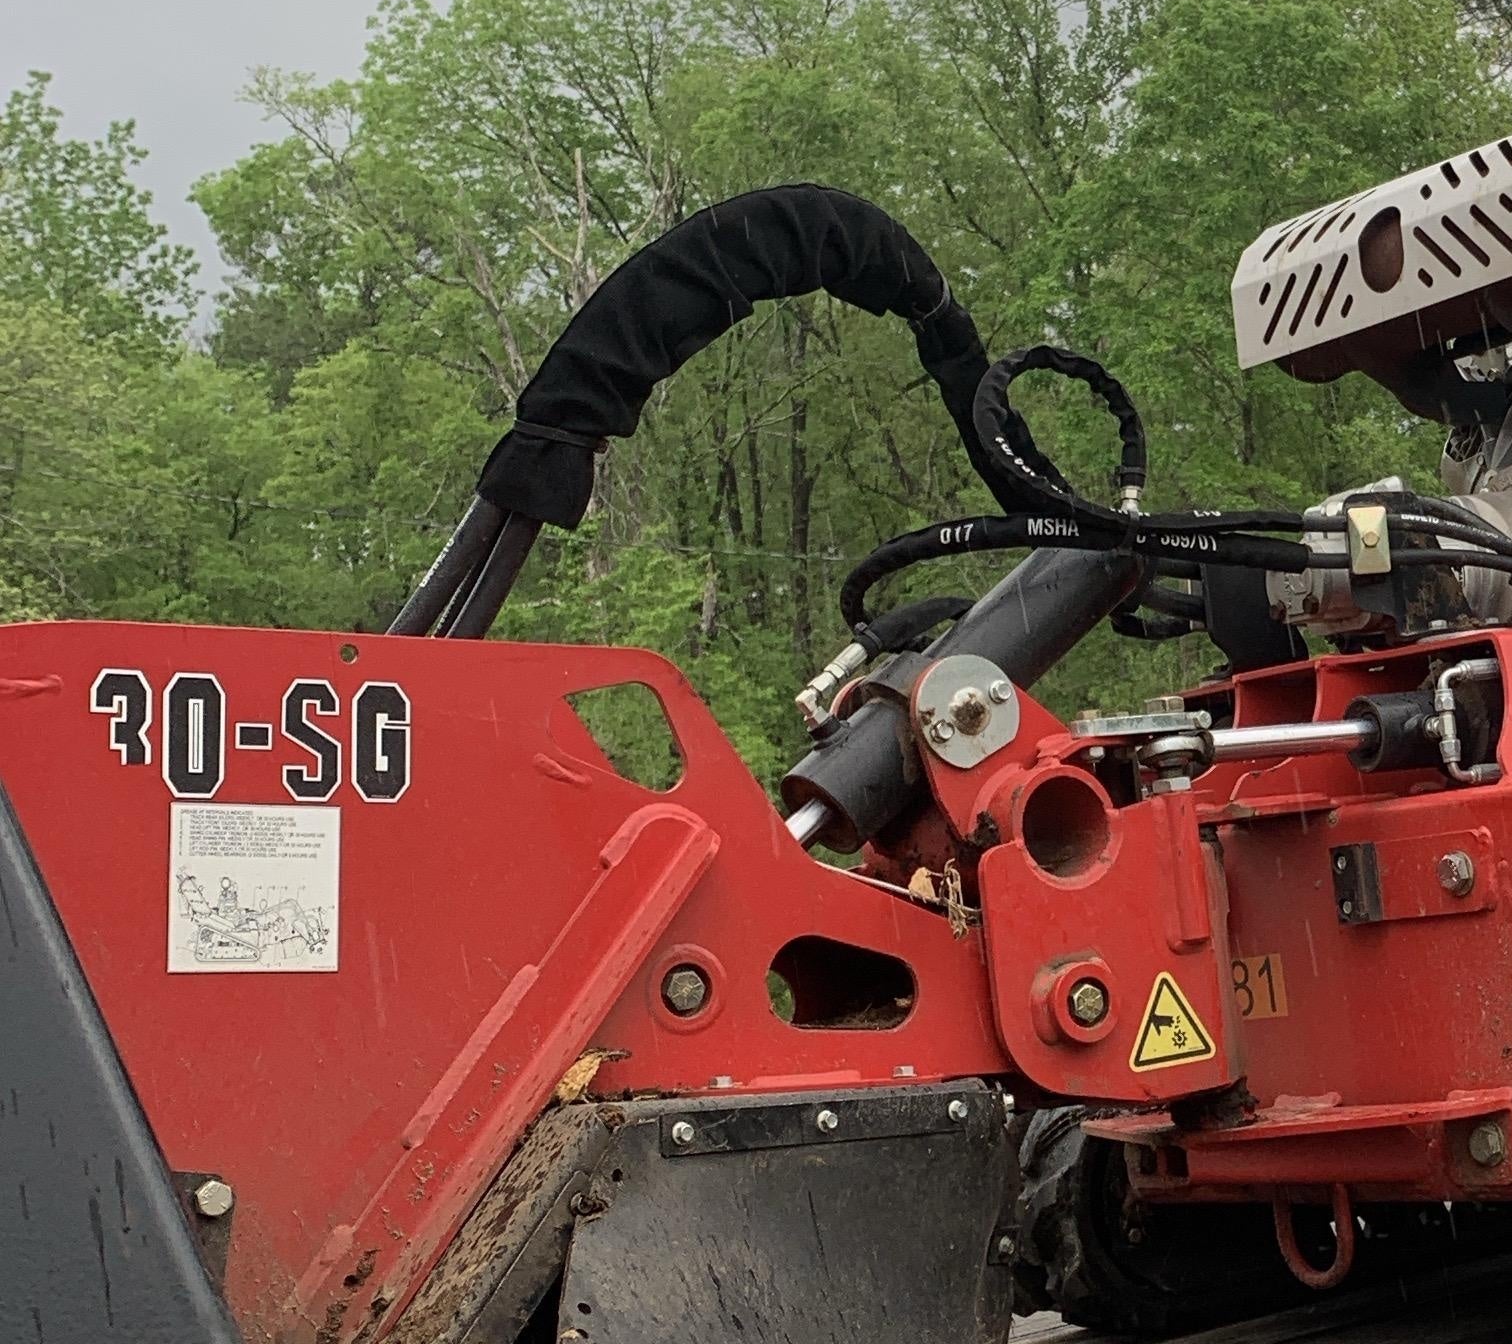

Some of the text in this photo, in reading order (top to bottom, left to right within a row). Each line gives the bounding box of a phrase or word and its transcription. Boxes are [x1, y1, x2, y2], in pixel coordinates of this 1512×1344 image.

[940, 523, 974, 545] 017
[1027, 517, 1080, 537] MSHA
[90, 668, 411, 803] 30-SG
